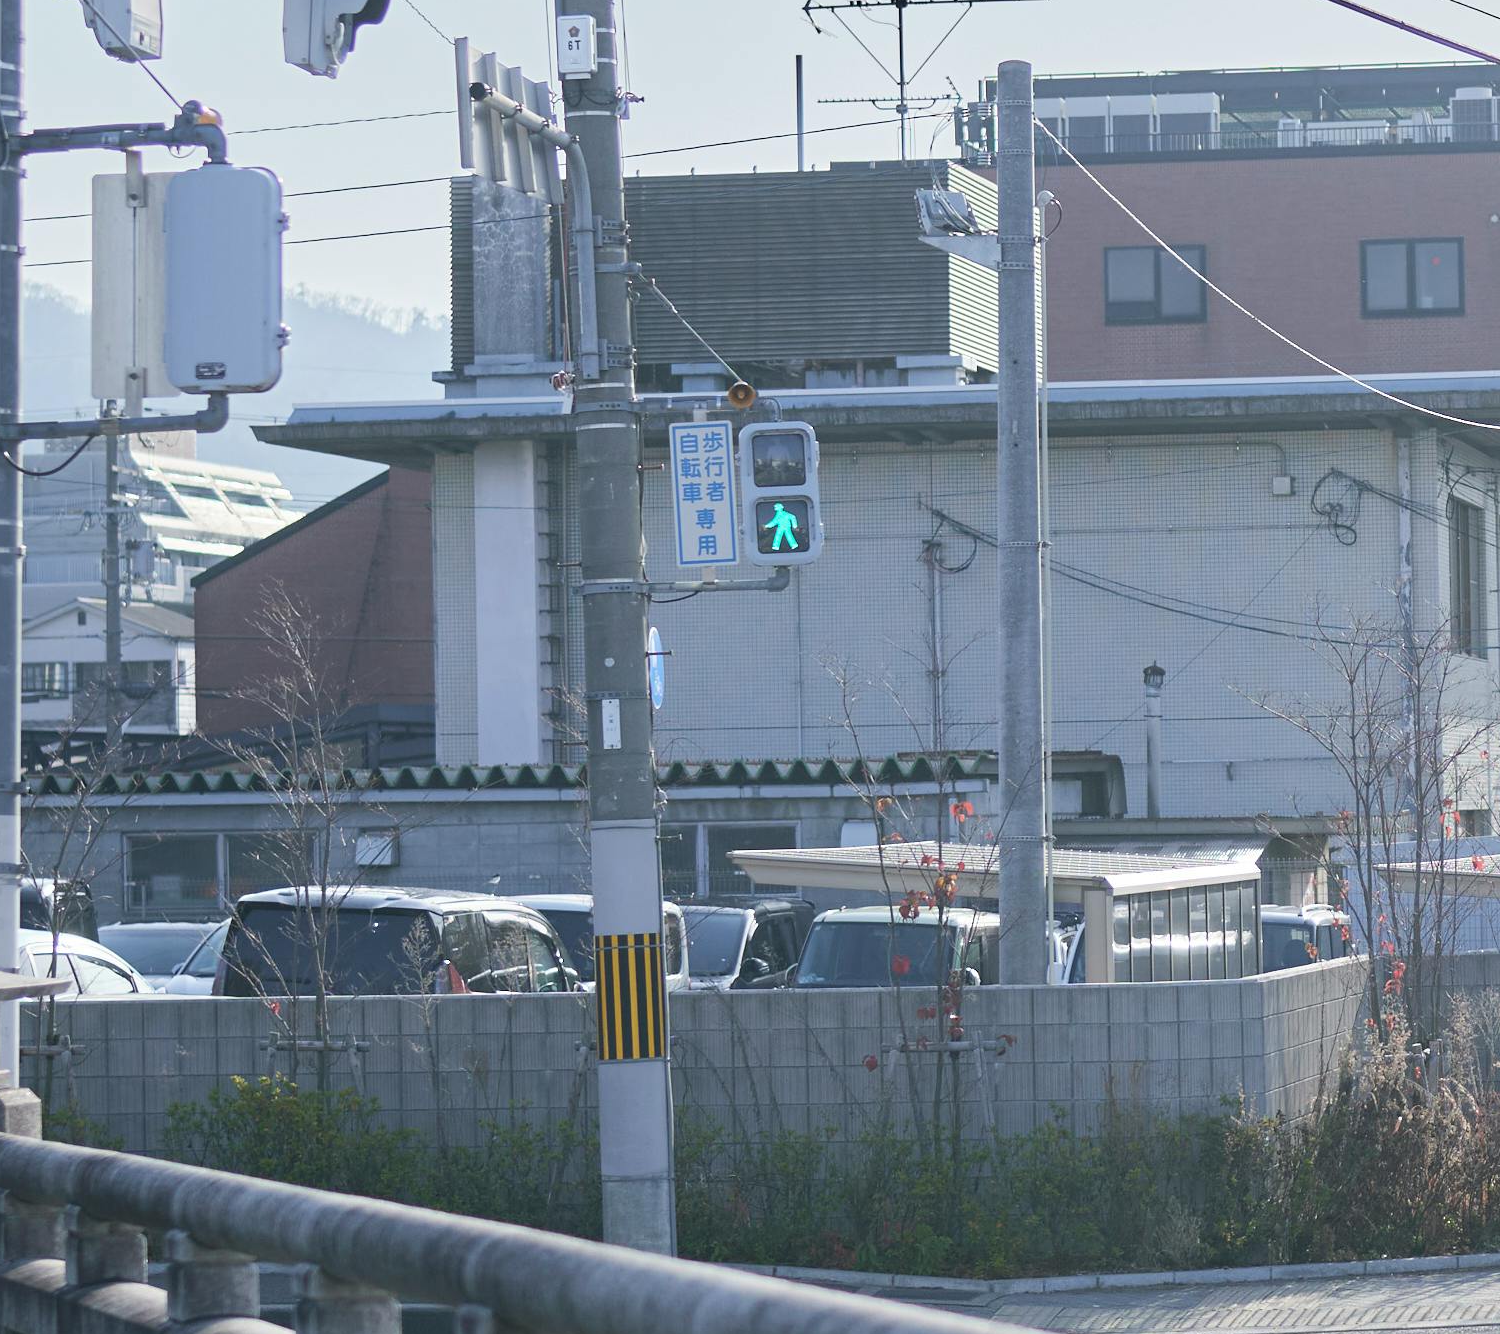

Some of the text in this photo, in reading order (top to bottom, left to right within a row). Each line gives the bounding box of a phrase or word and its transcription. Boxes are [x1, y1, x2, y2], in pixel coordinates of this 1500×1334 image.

[680, 433, 703, 504] 自転車
[703, 431, 726, 503] 歩行者
[695, 508, 718, 556] 専用
